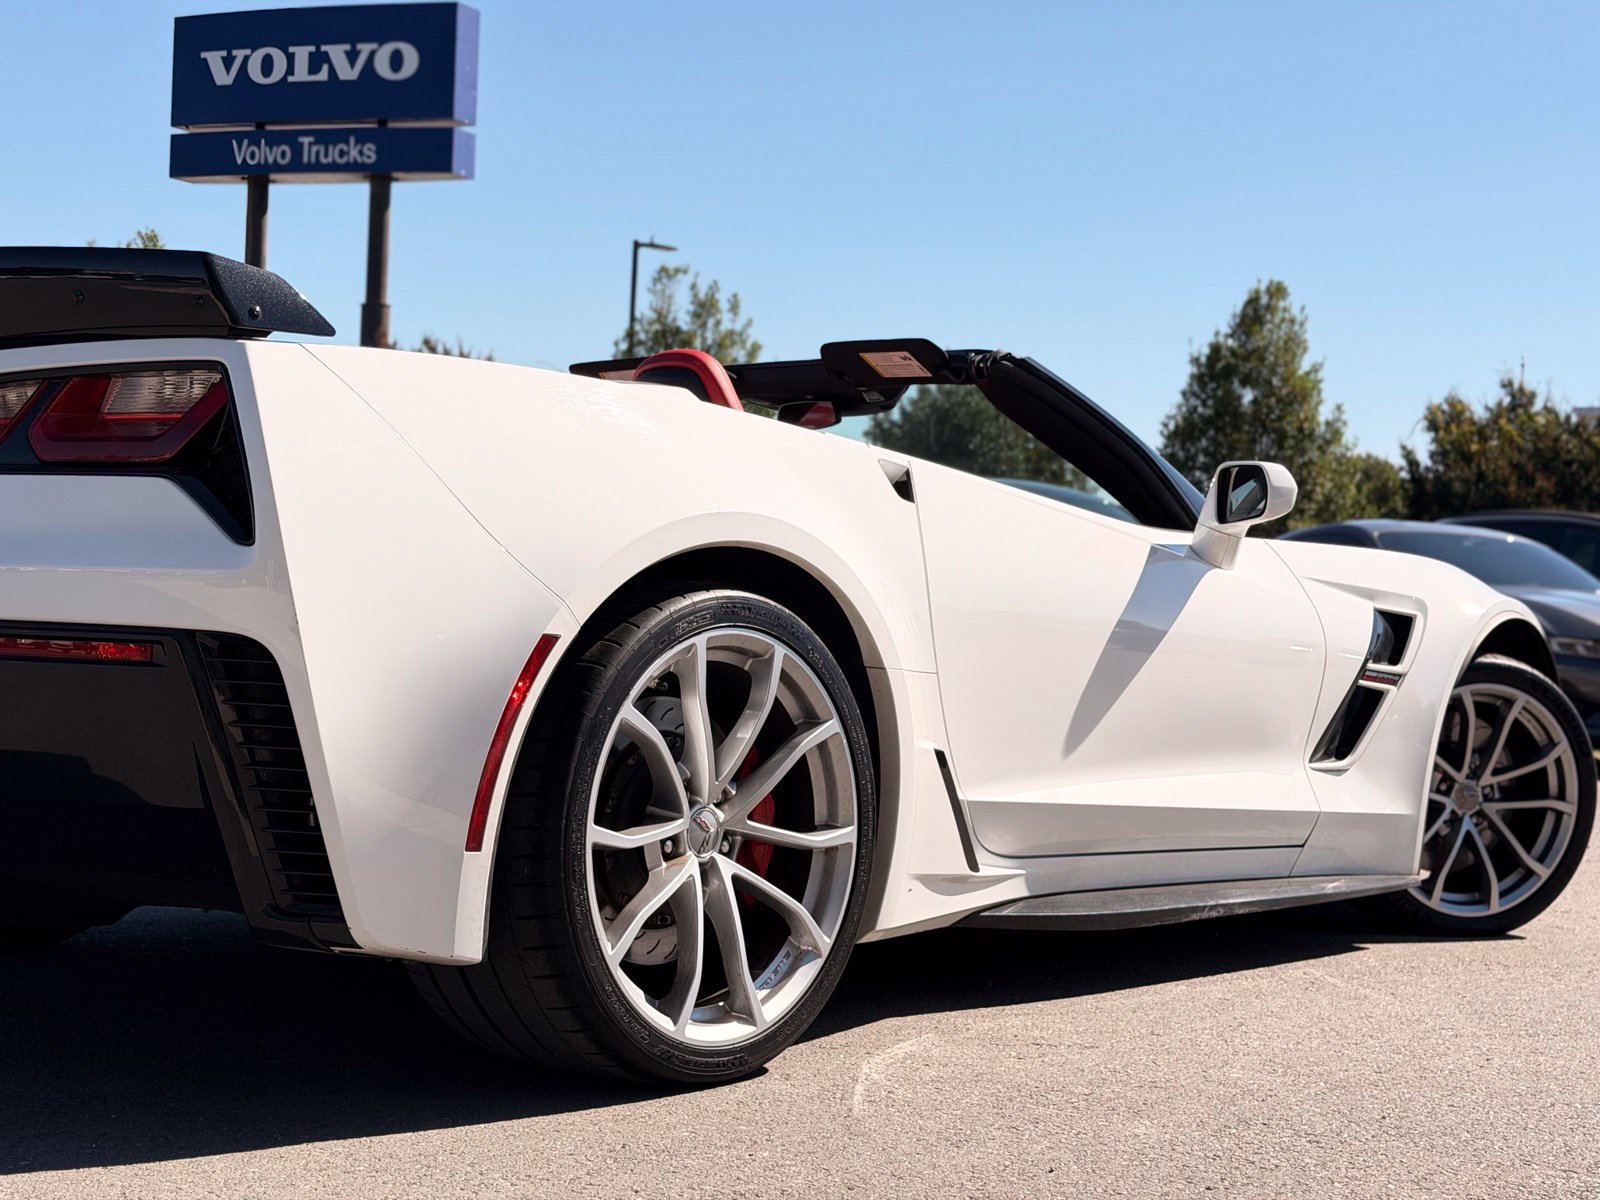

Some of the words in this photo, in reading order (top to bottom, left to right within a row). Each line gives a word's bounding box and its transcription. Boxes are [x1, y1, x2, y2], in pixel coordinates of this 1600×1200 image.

[200, 41, 420, 86] VOLVO
[232, 138, 291, 166] Volvo
[298, 136, 377, 165] Trucks
